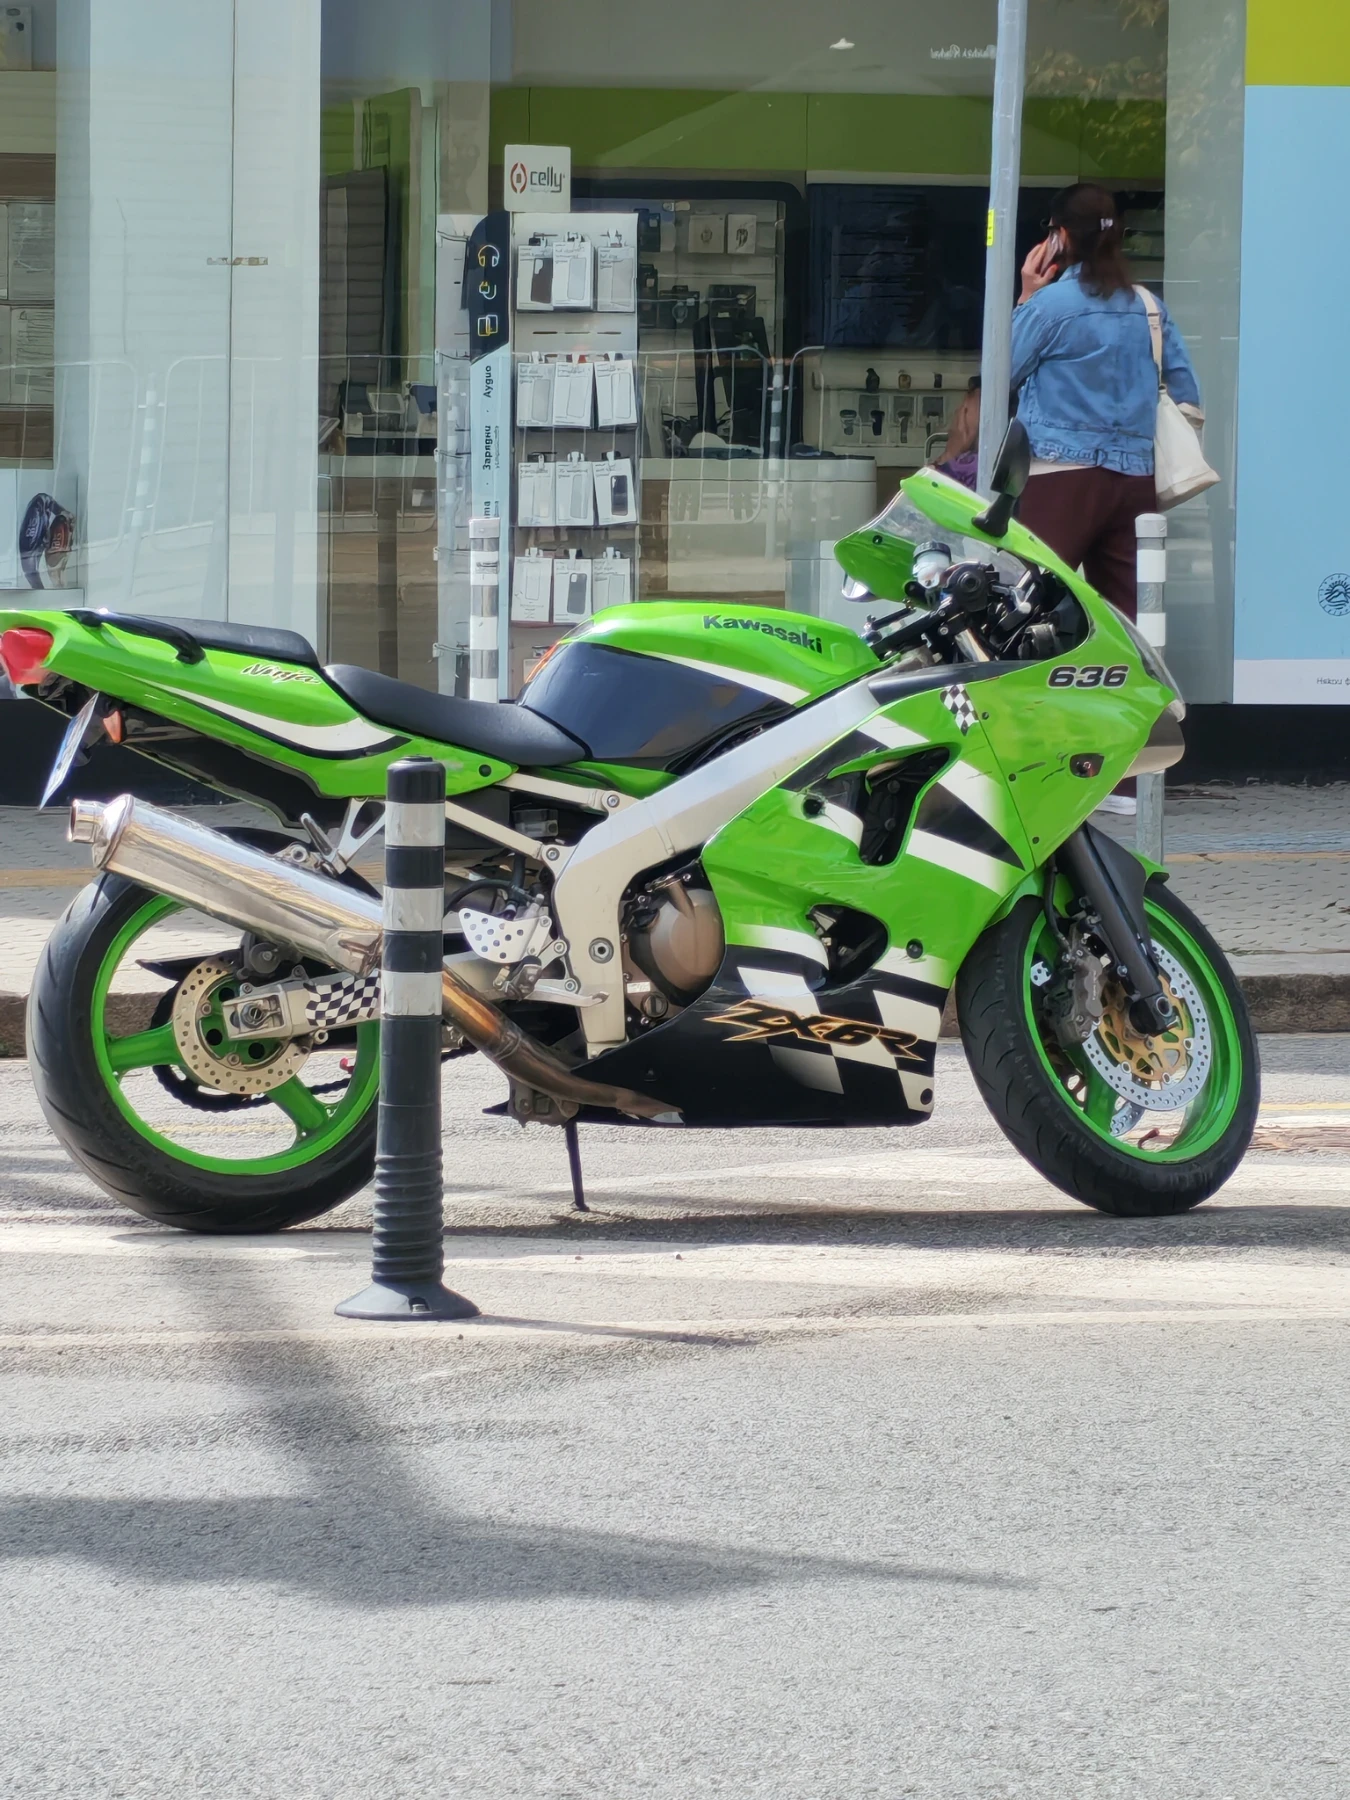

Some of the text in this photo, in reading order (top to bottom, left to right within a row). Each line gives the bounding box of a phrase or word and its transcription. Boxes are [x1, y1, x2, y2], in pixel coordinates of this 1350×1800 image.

[530, 166, 562, 193] celly
[483, 365, 493, 398] Аудио
[483, 425, 493, 471] Зарядни
[703, 613, 823, 655] Kawasaki
[241, 663, 321, 685] Ninja
[1047, 664, 1130, 690] 636
